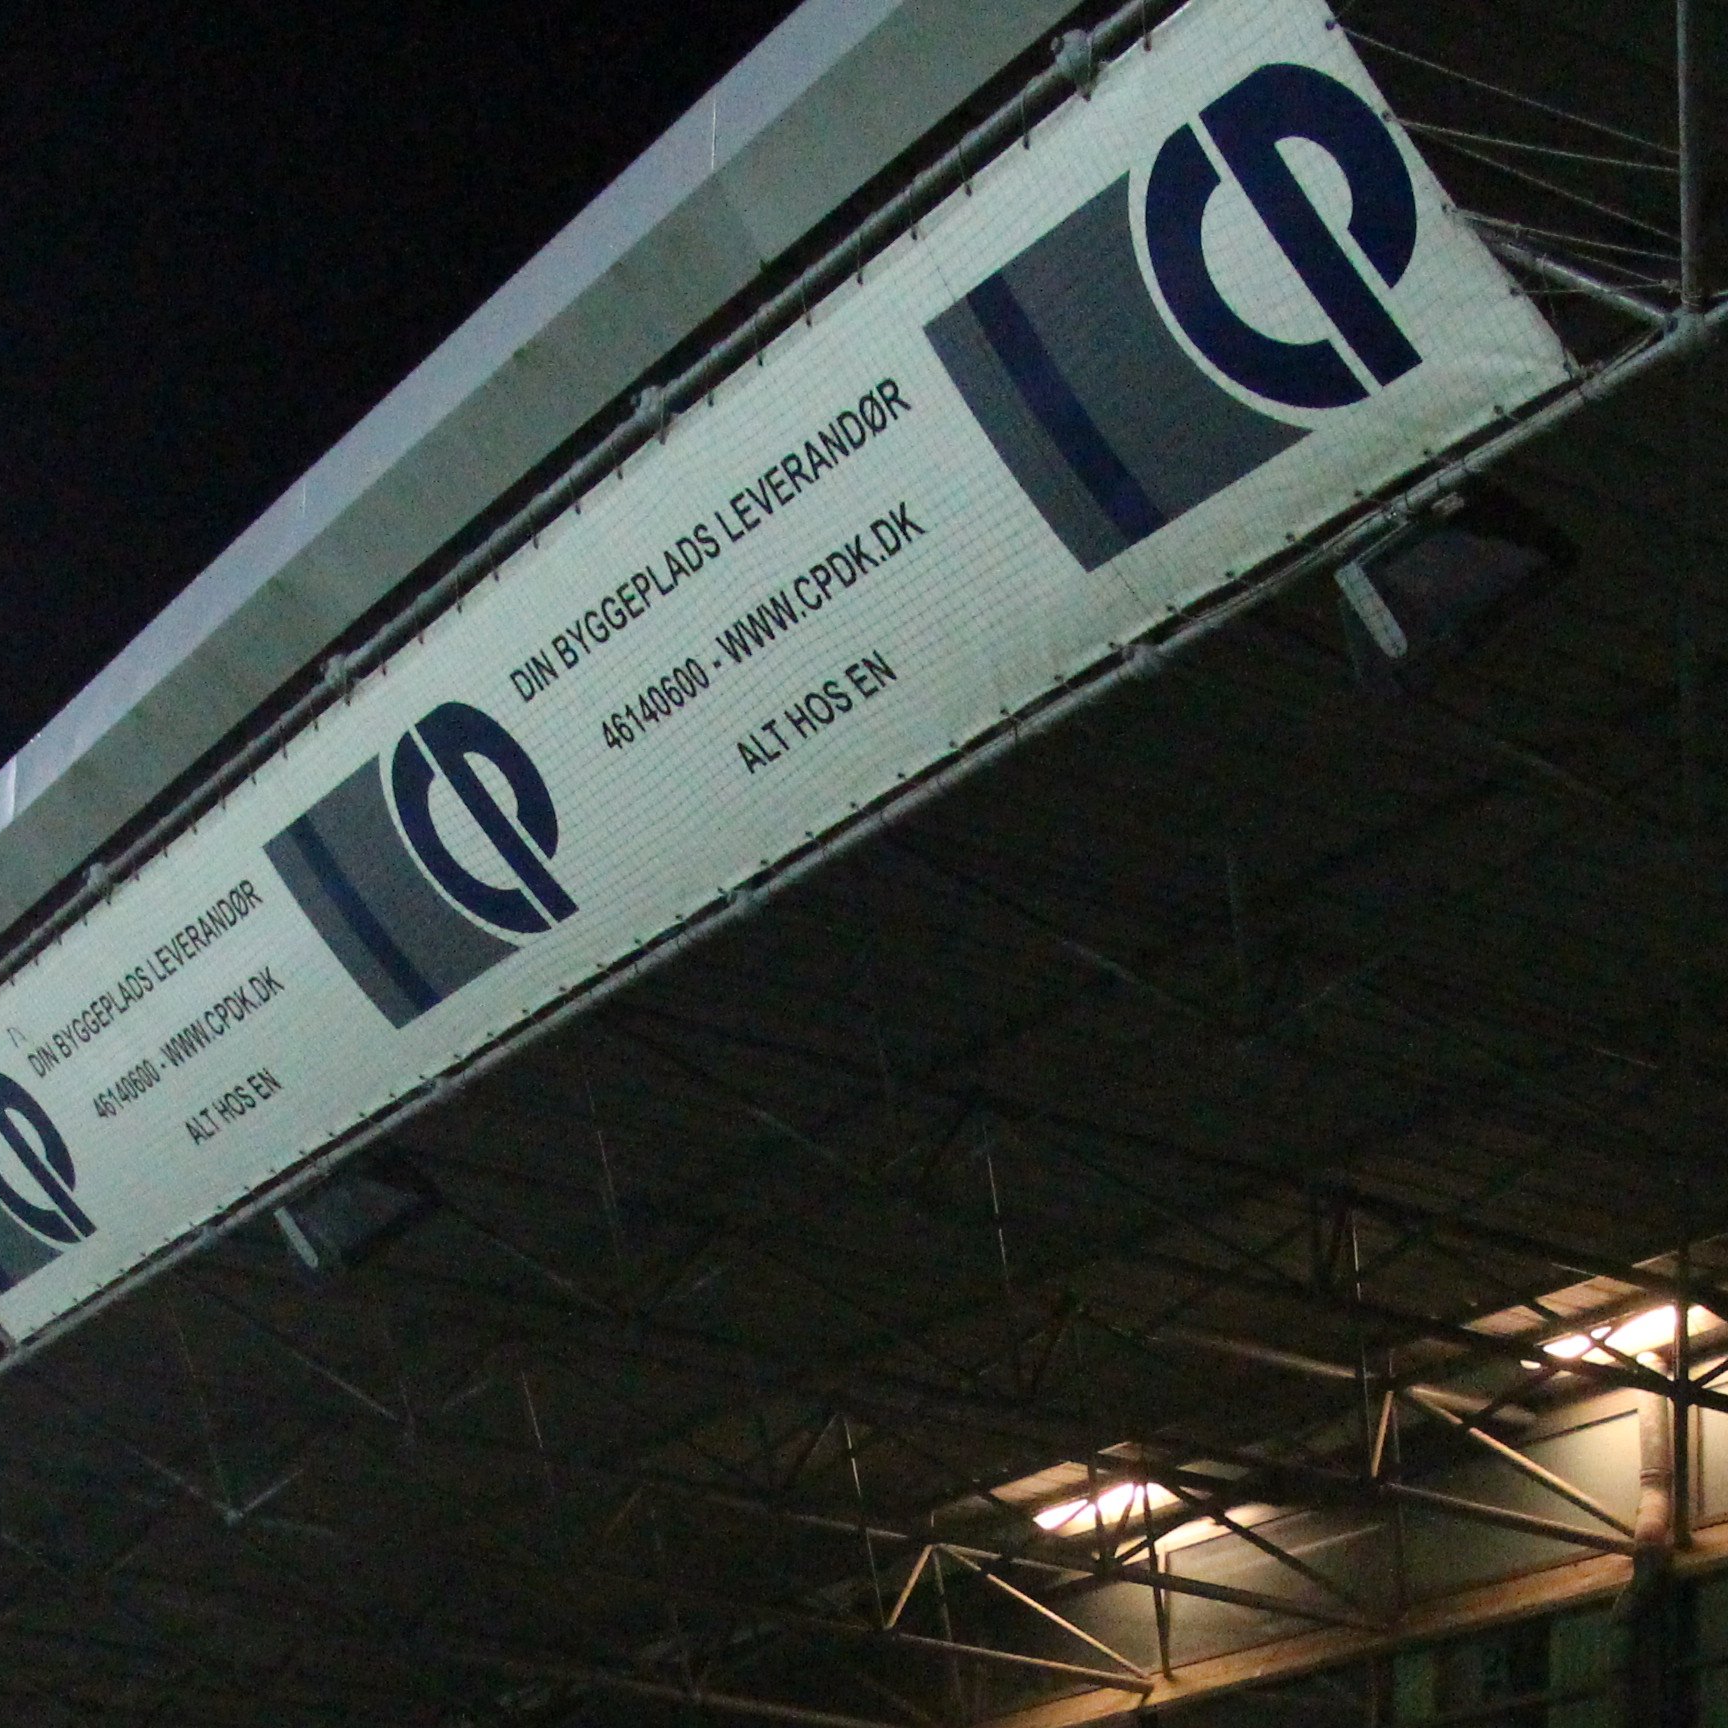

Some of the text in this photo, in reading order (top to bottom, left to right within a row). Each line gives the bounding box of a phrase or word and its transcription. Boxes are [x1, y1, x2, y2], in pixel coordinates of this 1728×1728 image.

[509, 377, 913, 702] DIN BYGGEPLADS LEVERANDØR
[602, 657, 710, 751] 46140600
[714, 501, 928, 665] WWW.CPDK.DK
[736, 649, 898, 775] ALT HOS EN
[27, 879, 264, 1079] DIN BYGGEPLADS LEVERANDØR
[92, 1058, 161, 1119] 46140600
[159, 965, 286, 1068] WWW.CPDK.DK
[184, 1066, 283, 1146] ALT HOS EN
